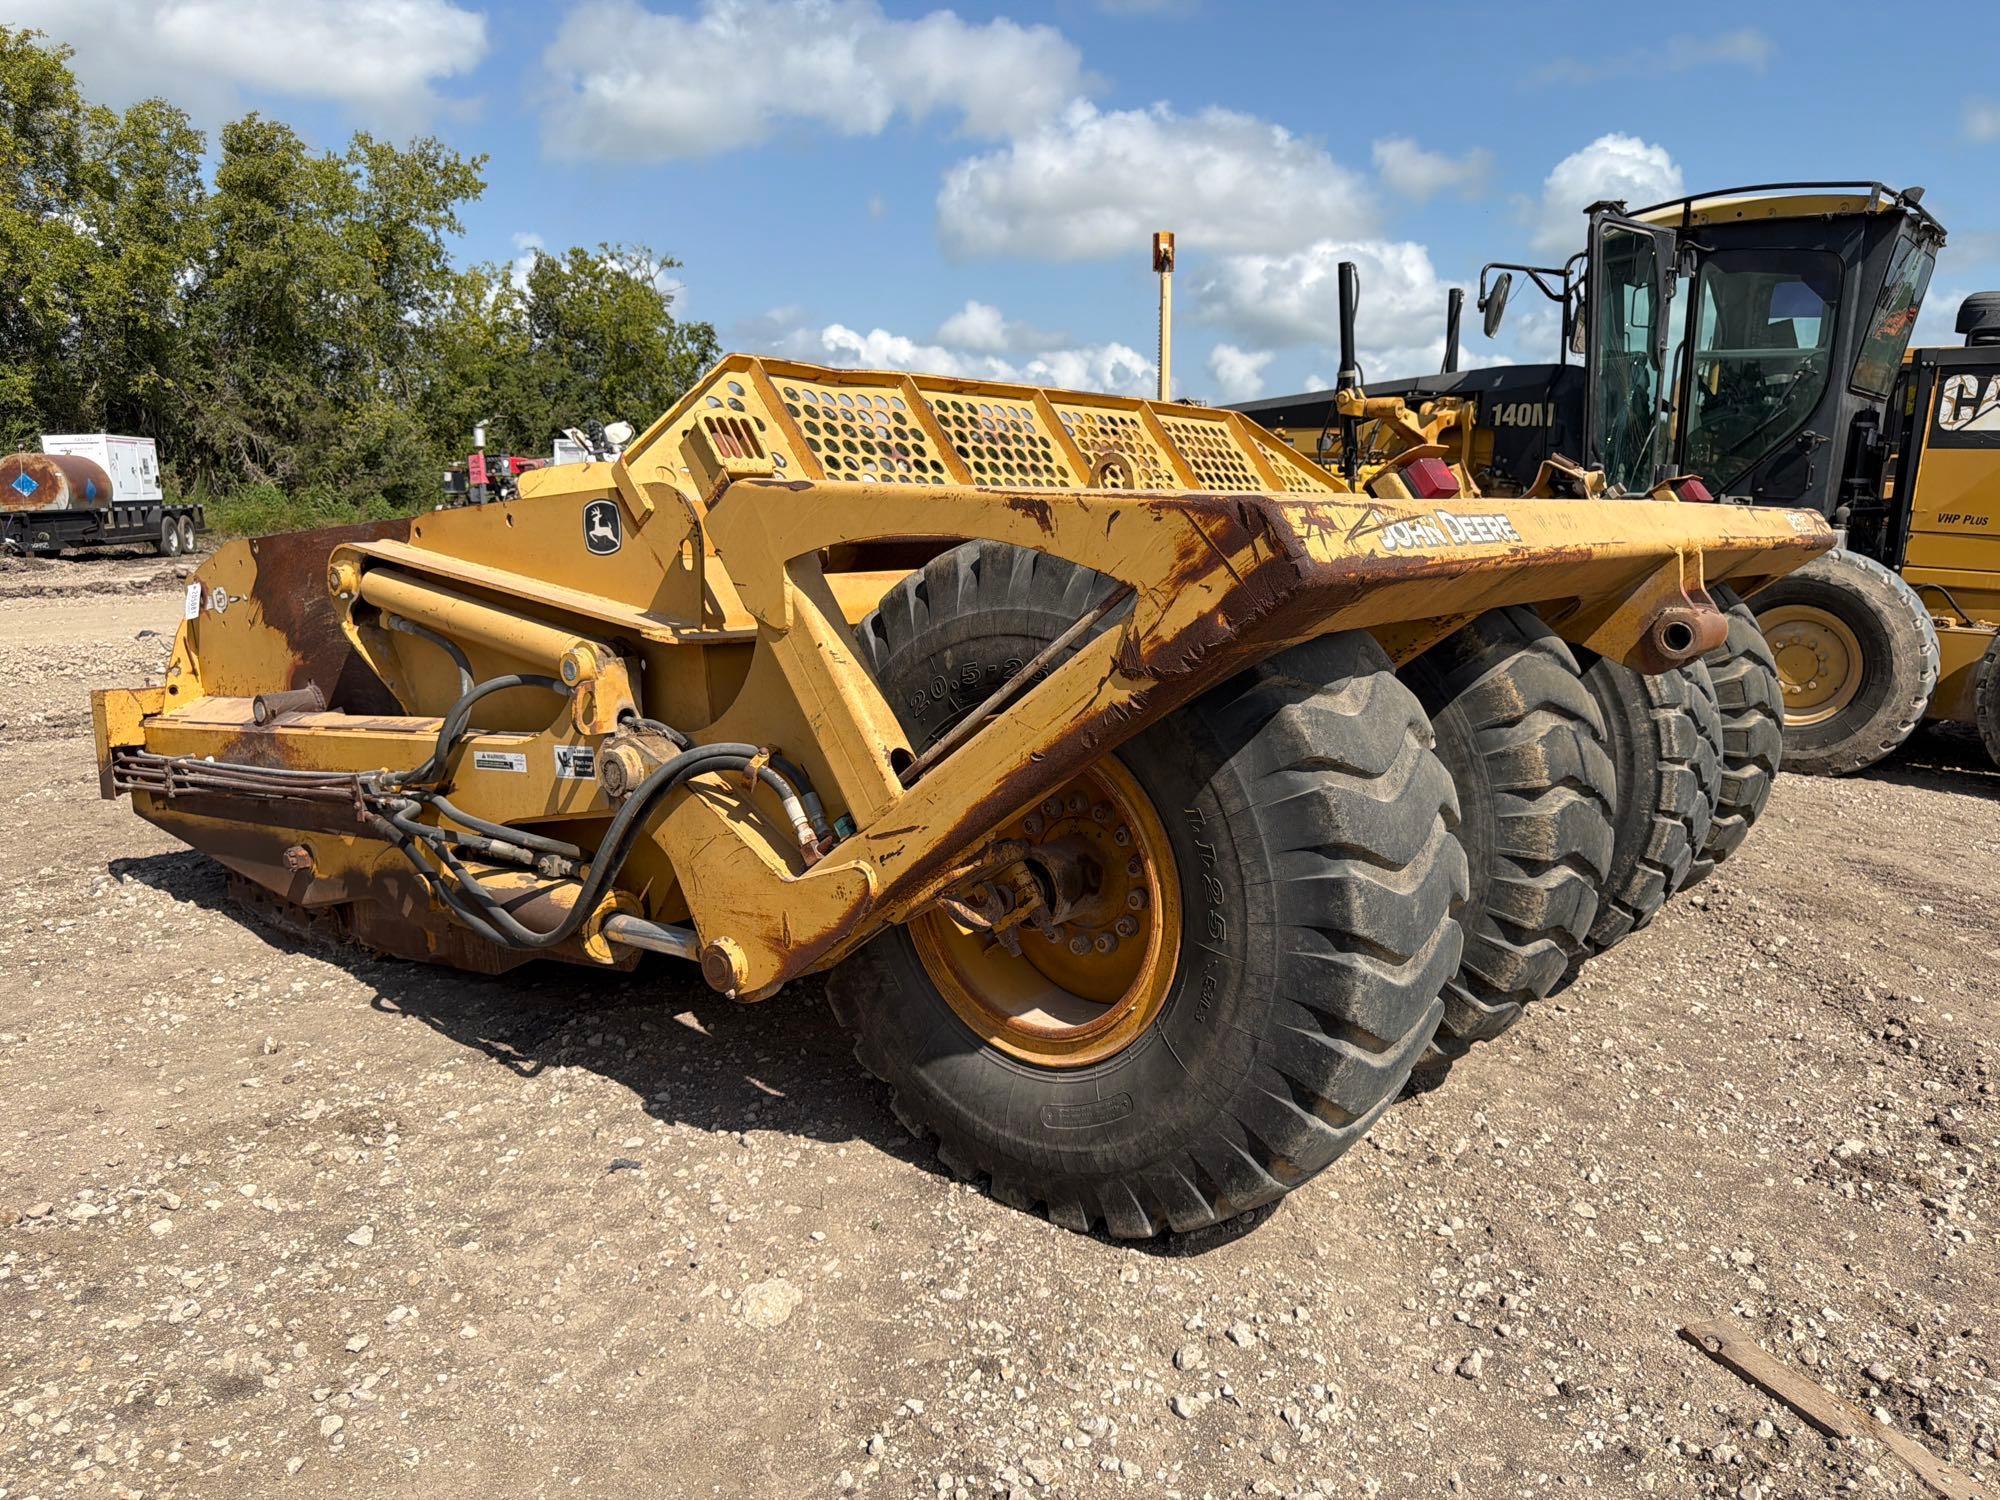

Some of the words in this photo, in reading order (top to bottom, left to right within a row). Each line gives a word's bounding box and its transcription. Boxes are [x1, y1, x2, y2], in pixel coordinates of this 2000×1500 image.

[1372, 509, 1449, 551] JOHN
[1433, 509, 1522, 546] DEERE
[1937, 513, 1961, 524] VHP
